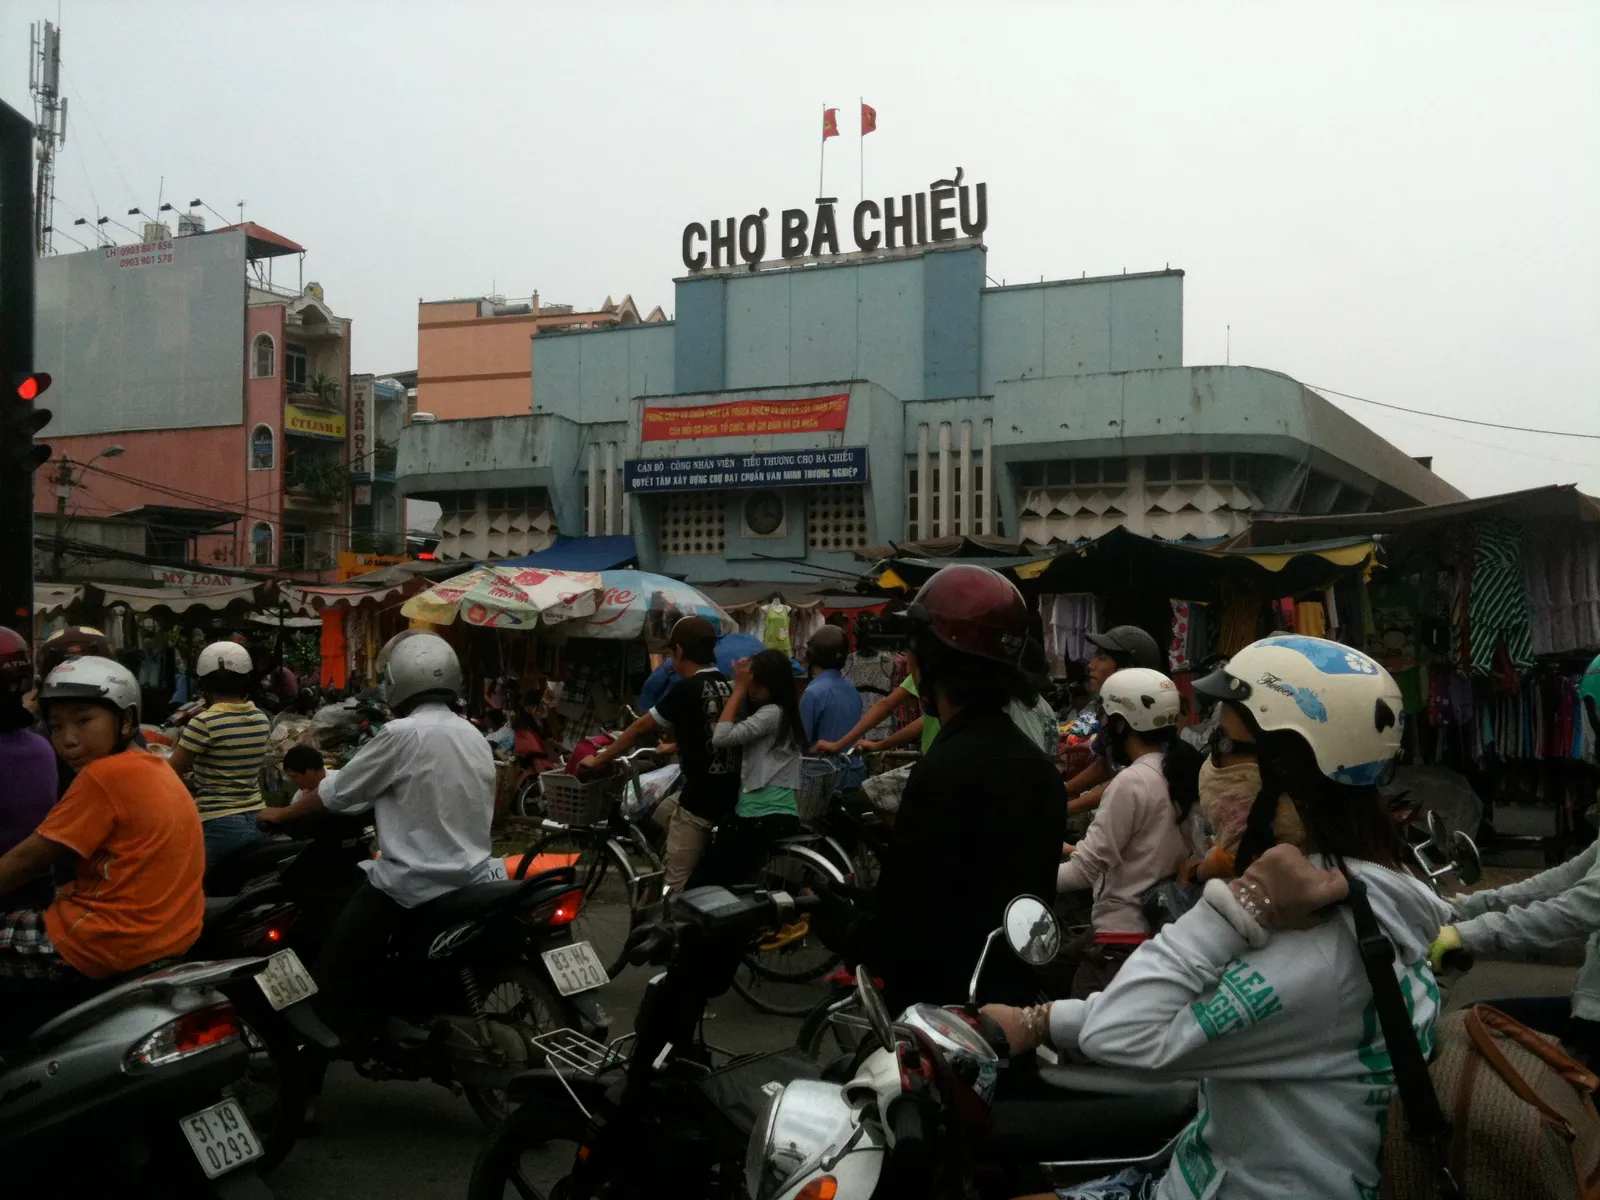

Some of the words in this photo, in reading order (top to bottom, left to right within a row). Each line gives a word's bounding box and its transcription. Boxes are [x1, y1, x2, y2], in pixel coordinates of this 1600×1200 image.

[683, 207, 769, 271] CHỢ
[853, 166, 987, 250] CHIỂU
[192, 574, 232, 586] LOAN
[562, 965, 600, 991] 1120
[206, 1132, 253, 1170] 0293
